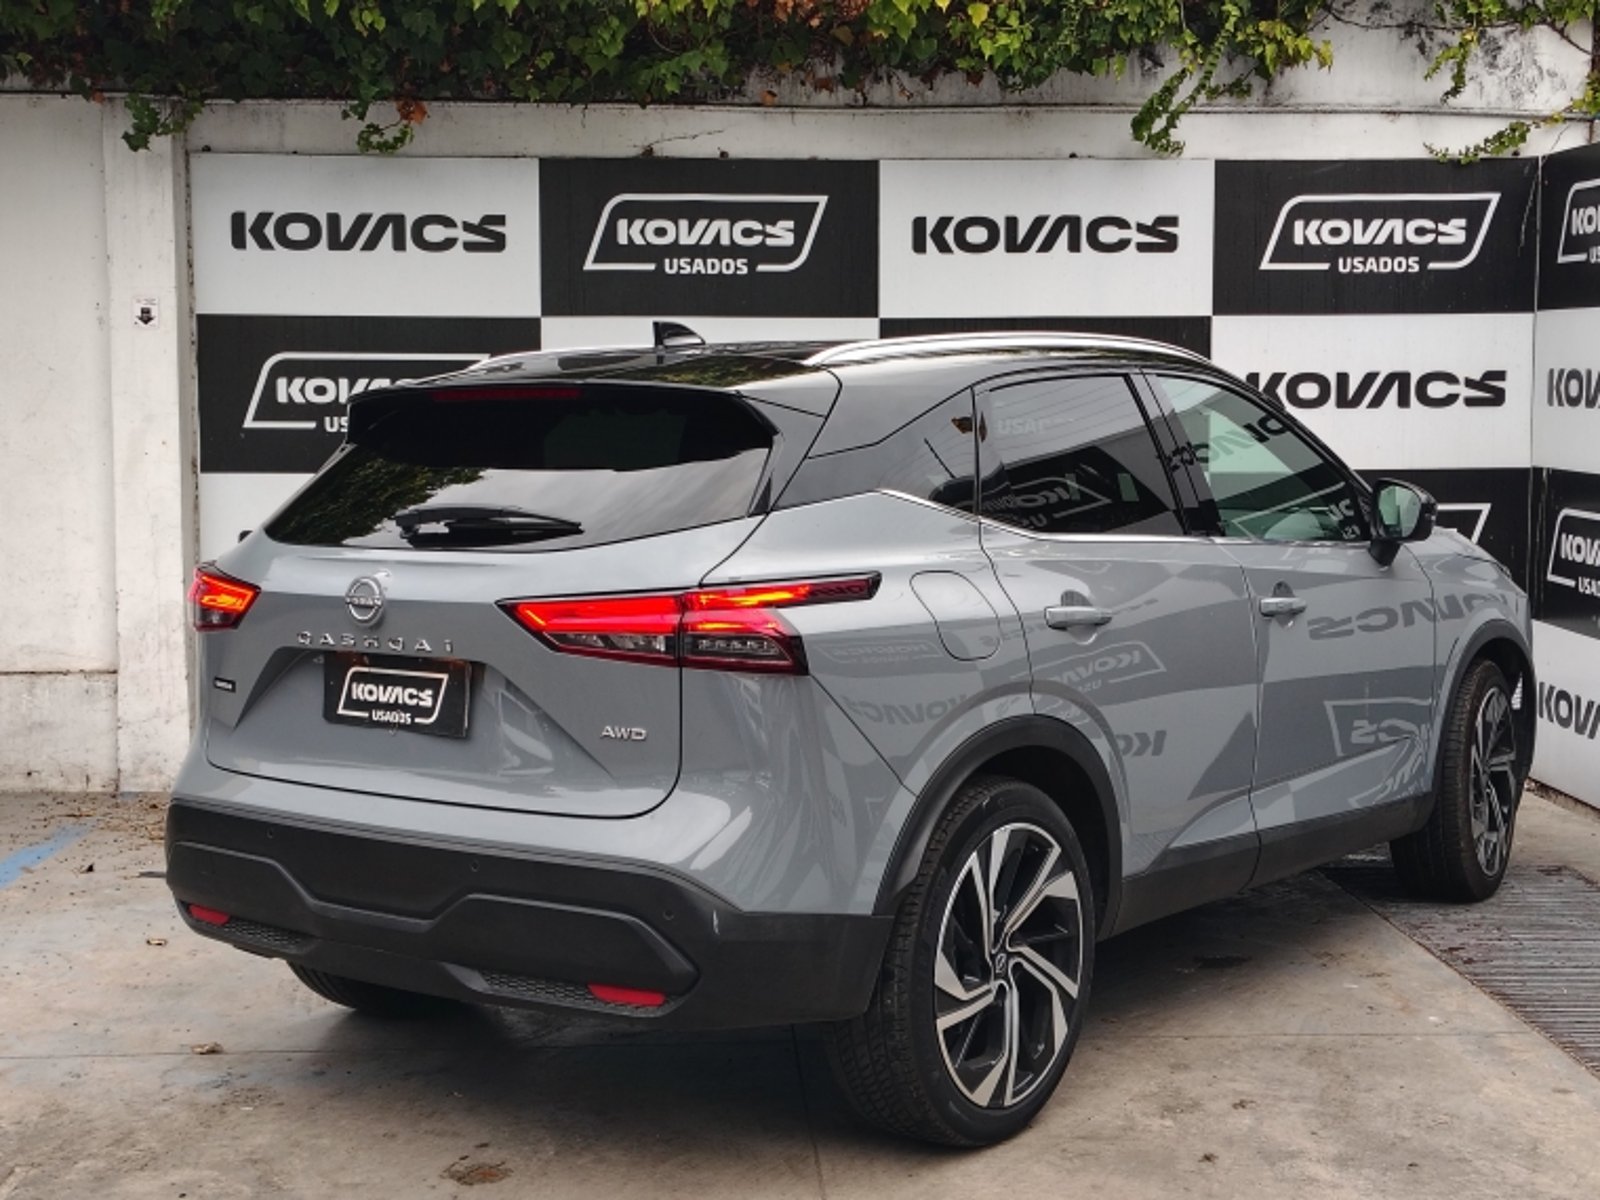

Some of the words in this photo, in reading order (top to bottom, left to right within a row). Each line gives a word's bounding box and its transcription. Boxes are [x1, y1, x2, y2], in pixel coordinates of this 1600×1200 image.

[230, 210, 507, 253] KOVACS
[616, 218, 795, 247] KOVACS
[1293, 218, 1467, 246] KOVACS
[1571, 204, 1600, 236] KO
[911, 214, 1179, 255] KOVACS
[664, 258, 749, 275] USADOS
[1338, 256, 1420, 274] USADOS
[1245, 370, 1507, 409] KOVACS
[351, 681, 433, 708] KOVACS
[372, 709, 412, 725] USADOS
[601, 726, 648, 741] AWD
